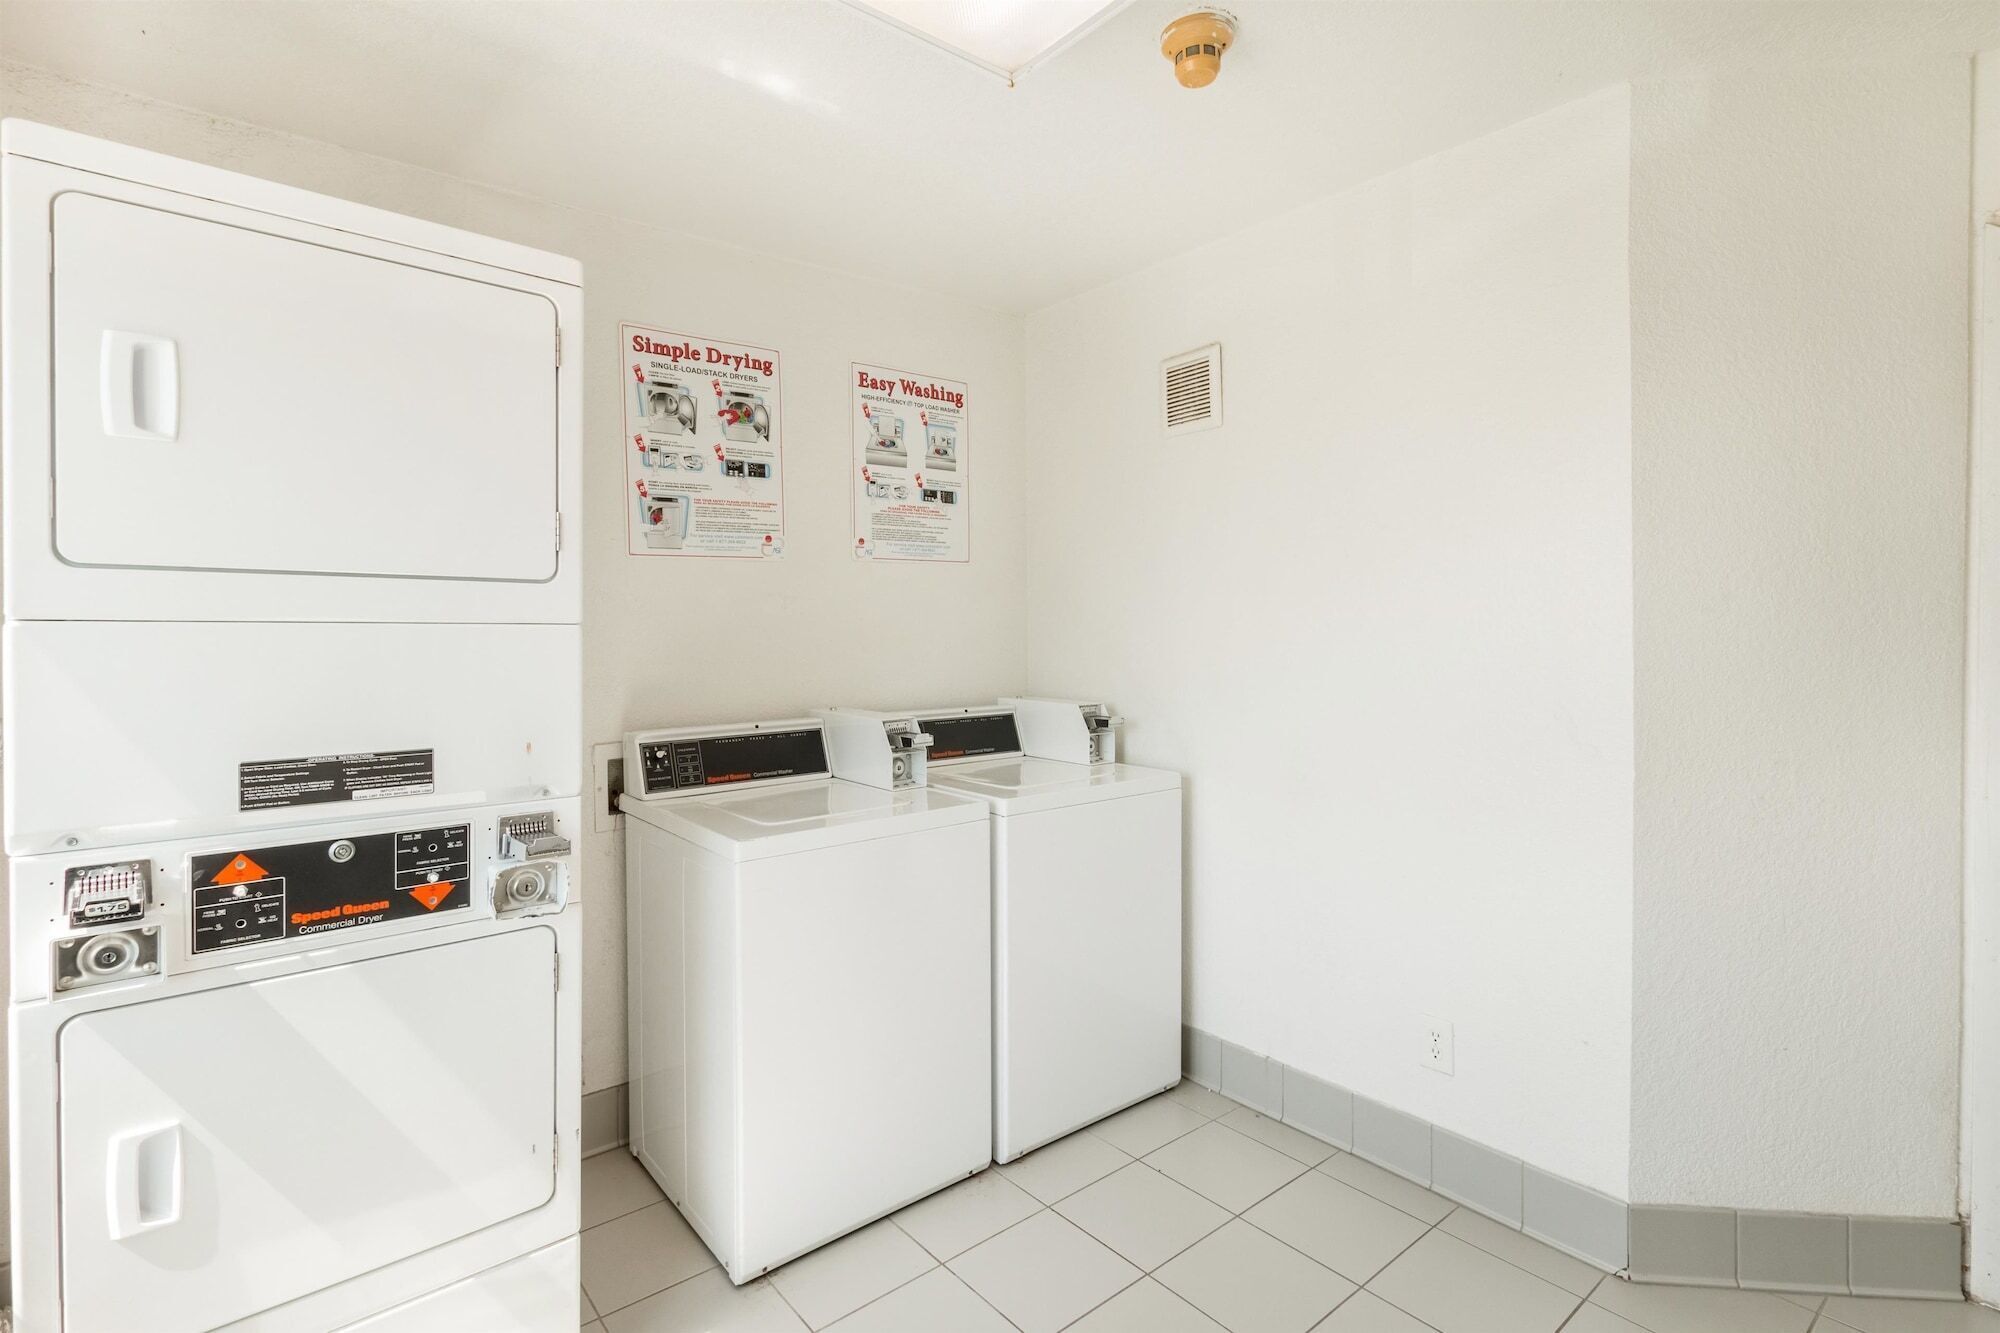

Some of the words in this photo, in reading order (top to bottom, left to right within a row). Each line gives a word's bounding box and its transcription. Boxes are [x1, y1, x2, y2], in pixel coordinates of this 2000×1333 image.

[632, 335, 700, 362] Simple
[706, 347, 773, 376] Drying
[650, 361, 728, 379] SINGLE-LOAD/STACK
[730, 373, 758, 382] DRYERS
[858, 372, 896, 396] Easy
[900, 378, 964, 408] Washing
[88, 902, 127, 914] $1.75
[291, 906, 340, 924] Speed
[342, 900, 390, 914] Queen
[299, 918, 356, 934] Commercial
[358, 914, 384, 924] Dryer
